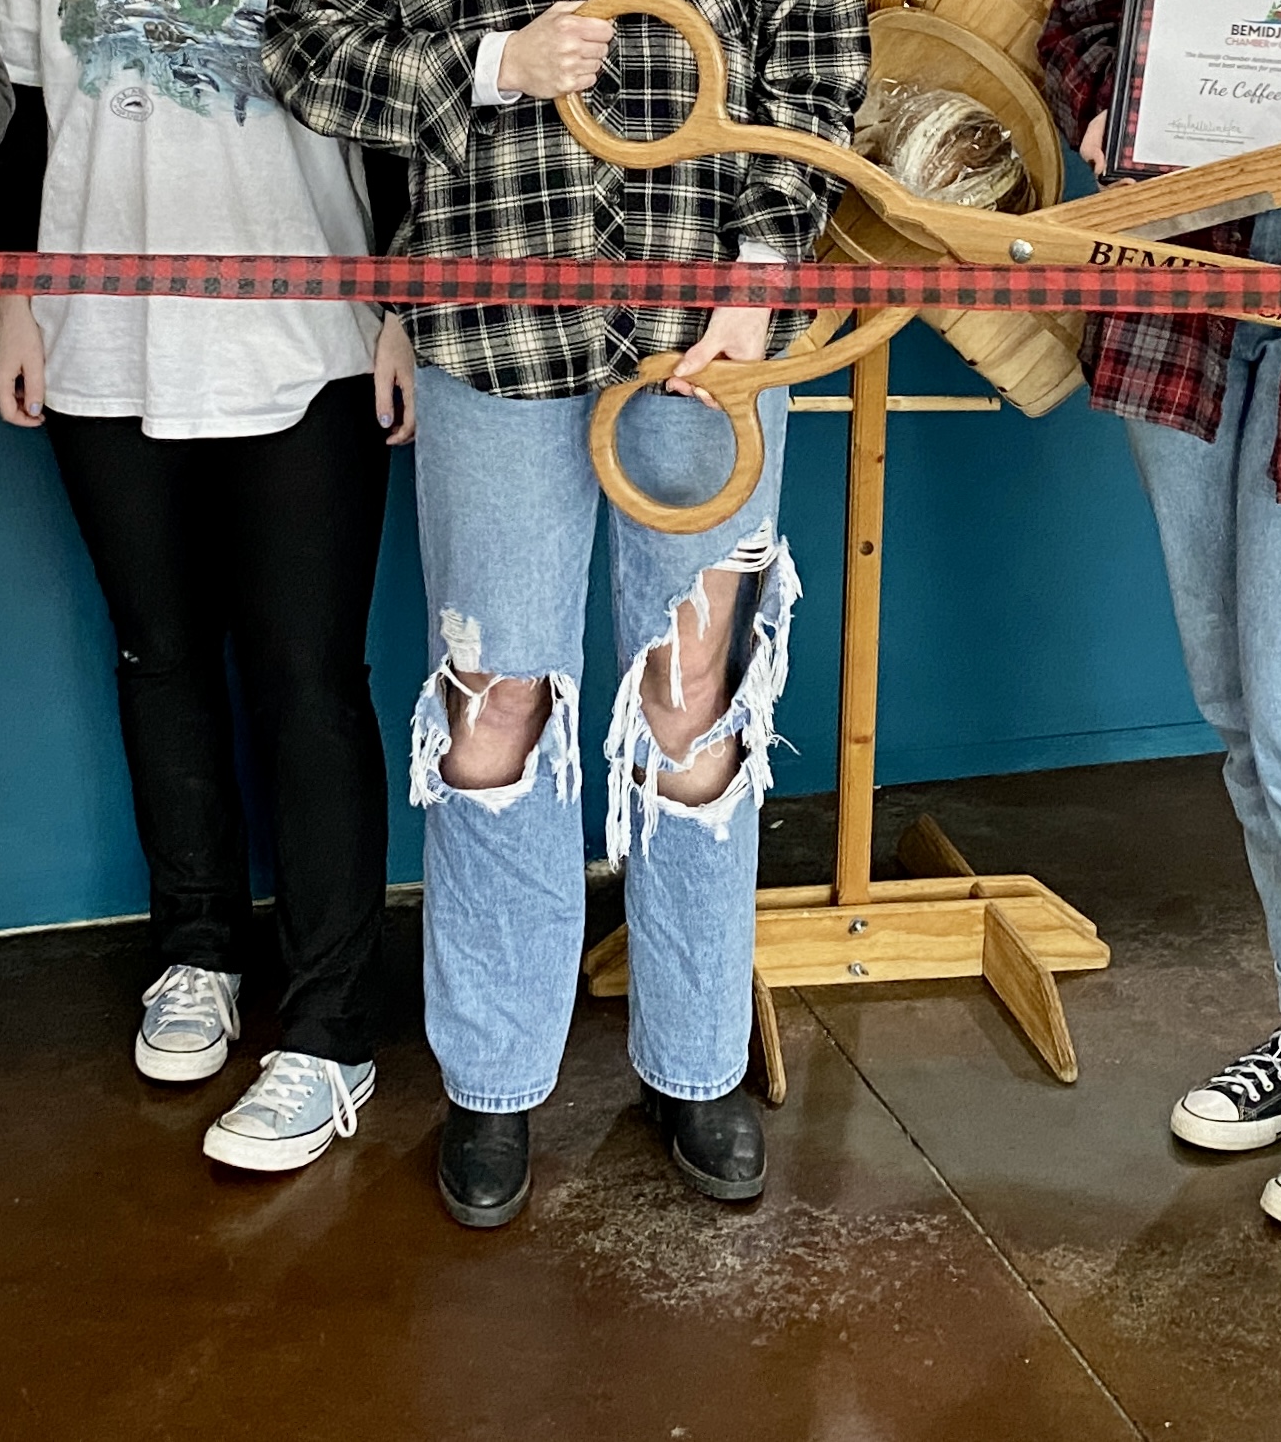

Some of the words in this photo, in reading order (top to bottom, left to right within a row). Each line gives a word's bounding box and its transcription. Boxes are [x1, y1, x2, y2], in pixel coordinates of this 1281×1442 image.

[1225, 36, 1270, 50] CHAMBER
[1199, 78, 1227, 97] The
[1232, 81, 1281, 104] Coffee
